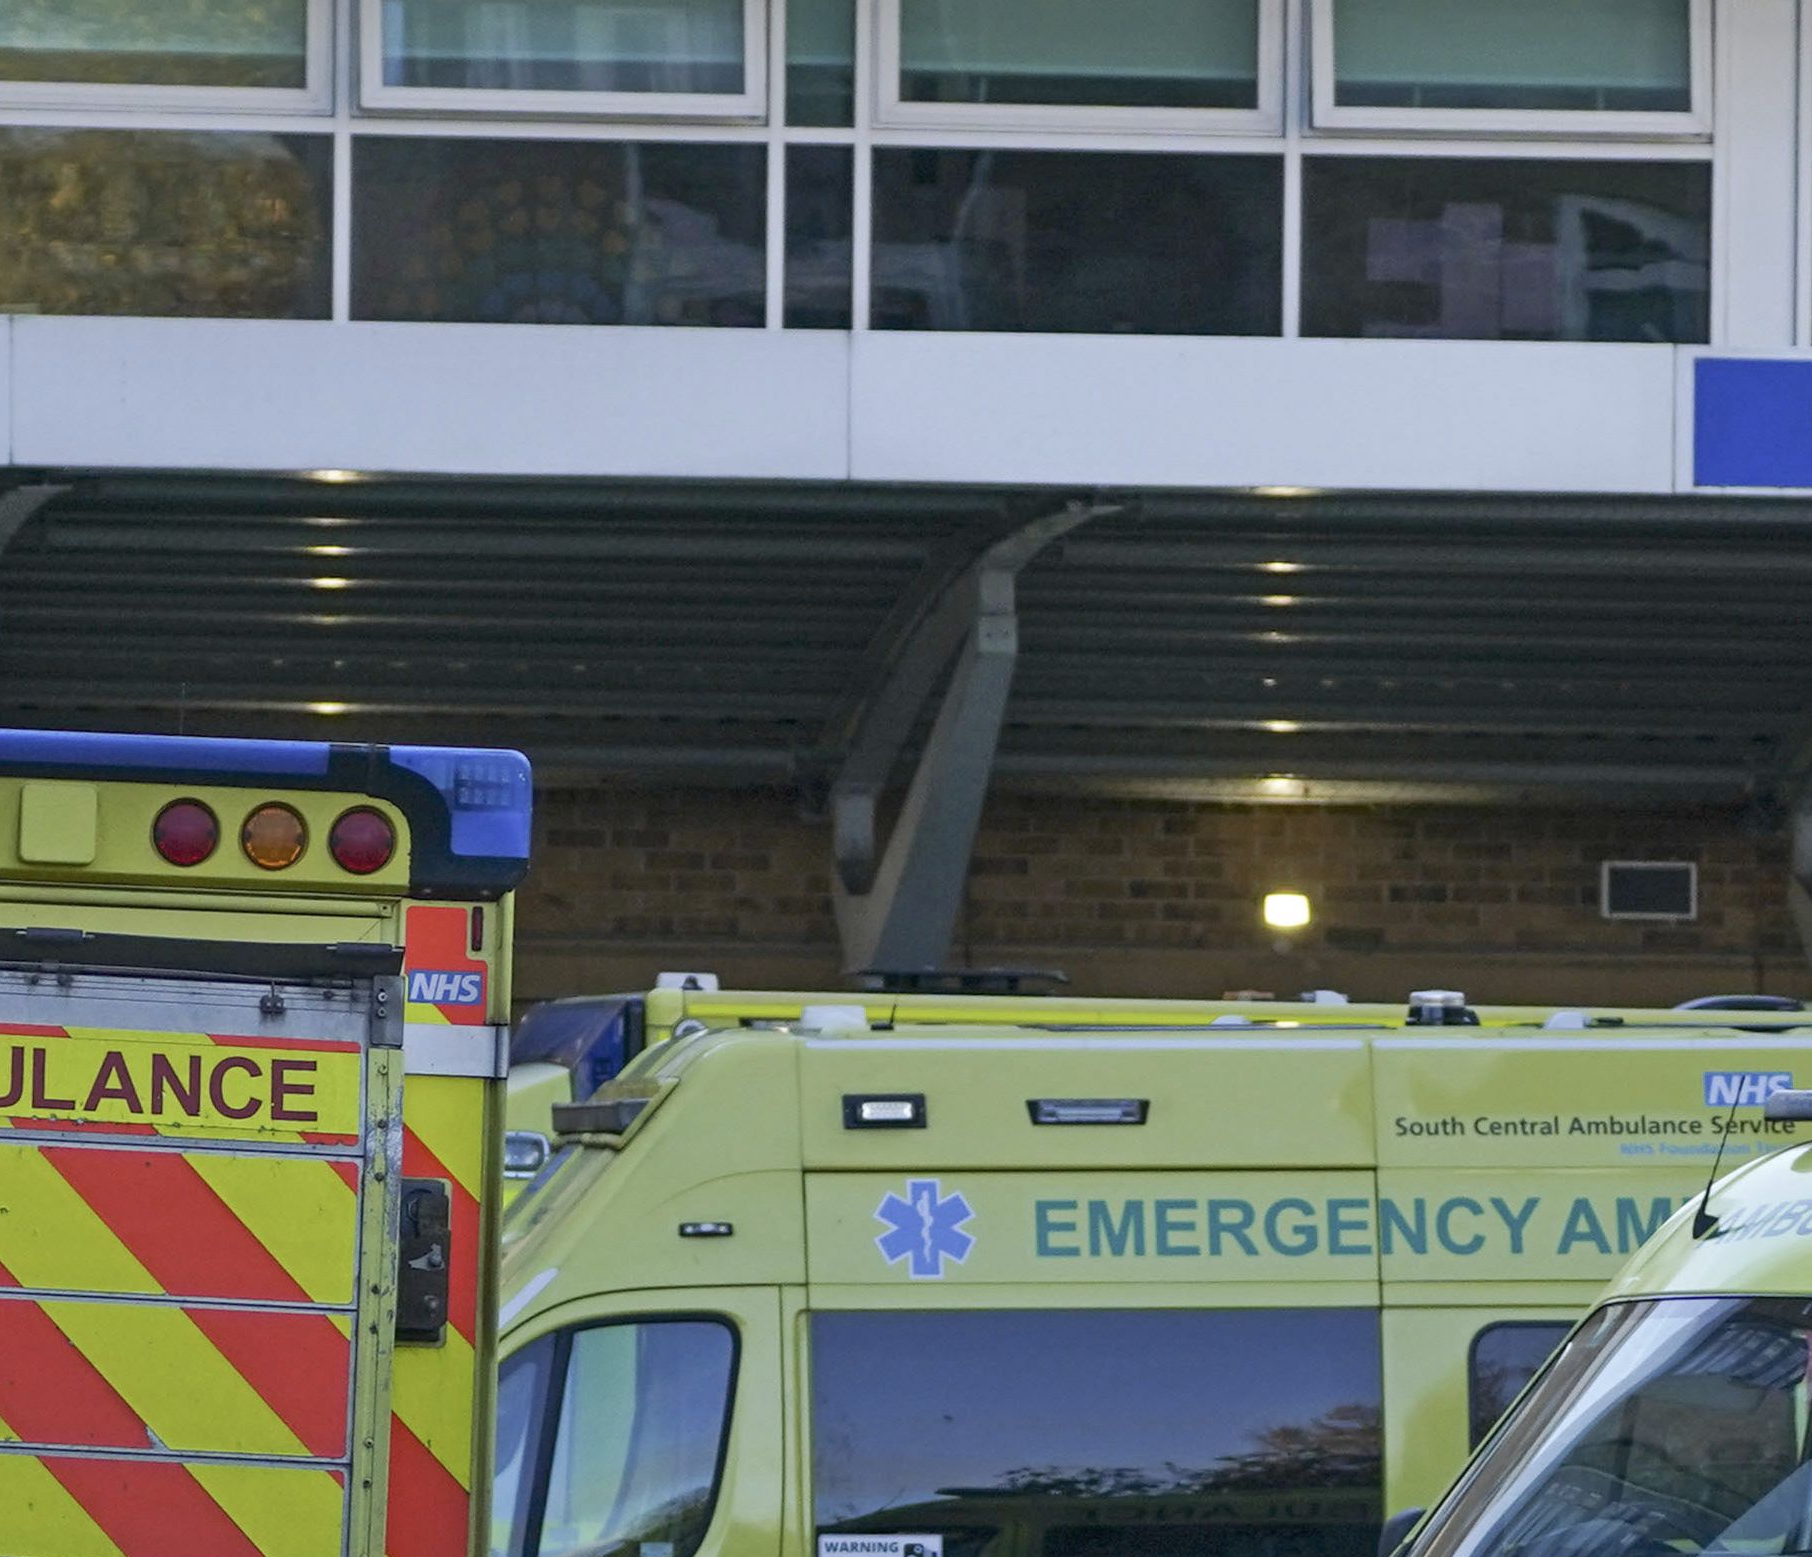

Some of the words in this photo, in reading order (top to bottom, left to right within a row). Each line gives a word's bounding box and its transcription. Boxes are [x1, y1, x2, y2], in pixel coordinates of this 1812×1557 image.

[408, 971, 482, 1003] NHS
[1707, 1073, 1792, 1105] NHS
[1393, 1115, 1466, 1137] South
[1473, 1115, 1560, 1136] Central
[1567, 1115, 1703, 1136] Ambulance
[1710, 1115, 1796, 1135] Service
[1033, 1196, 1542, 1258] EMERGENCY
[824, 1541, 900, 1554] WARNING
